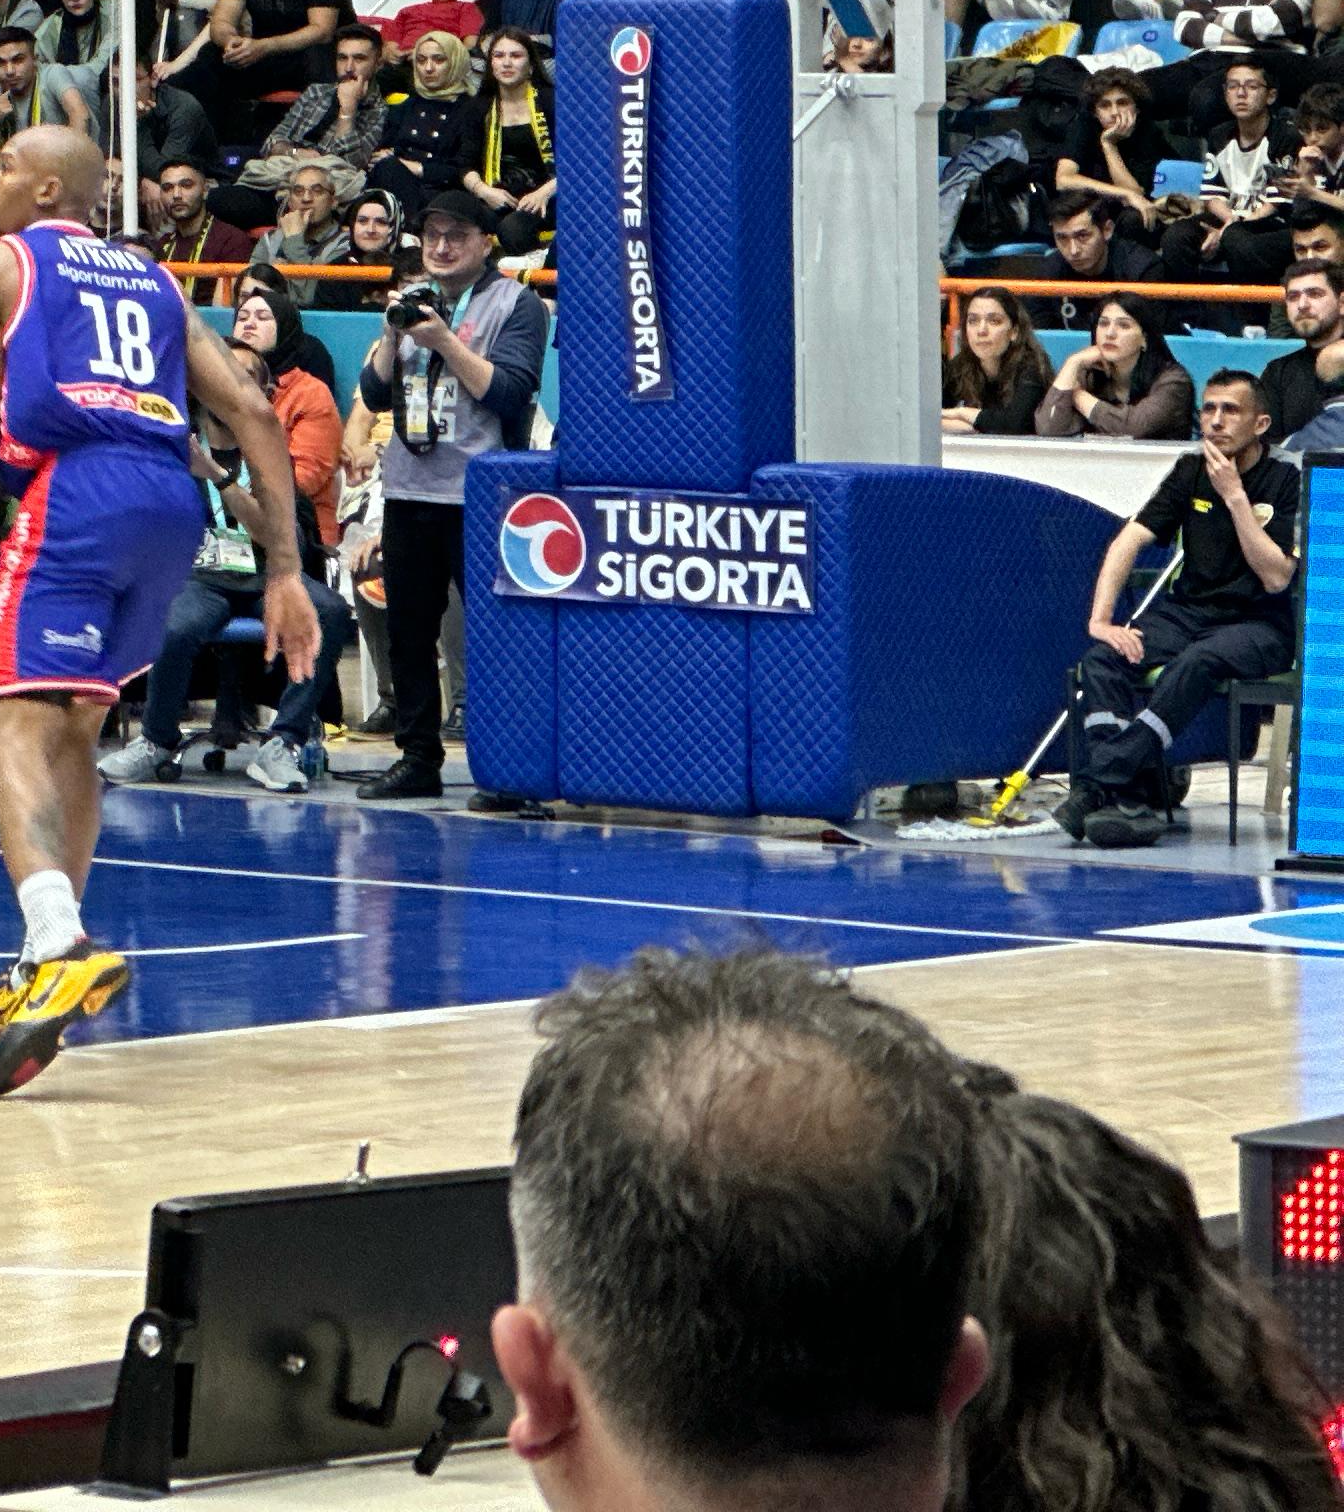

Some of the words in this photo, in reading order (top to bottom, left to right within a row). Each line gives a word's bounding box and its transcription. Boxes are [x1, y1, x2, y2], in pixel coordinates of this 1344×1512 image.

[618, 78, 645, 229] TÜRKİYE
[57, 262, 161, 293] sigortam.net
[627, 238, 662, 394] SİGORTA
[79, 291, 156, 386] 18
[595, 498, 808, 555] TÜRKİYE
[596, 551, 812, 610] SİGORTA
